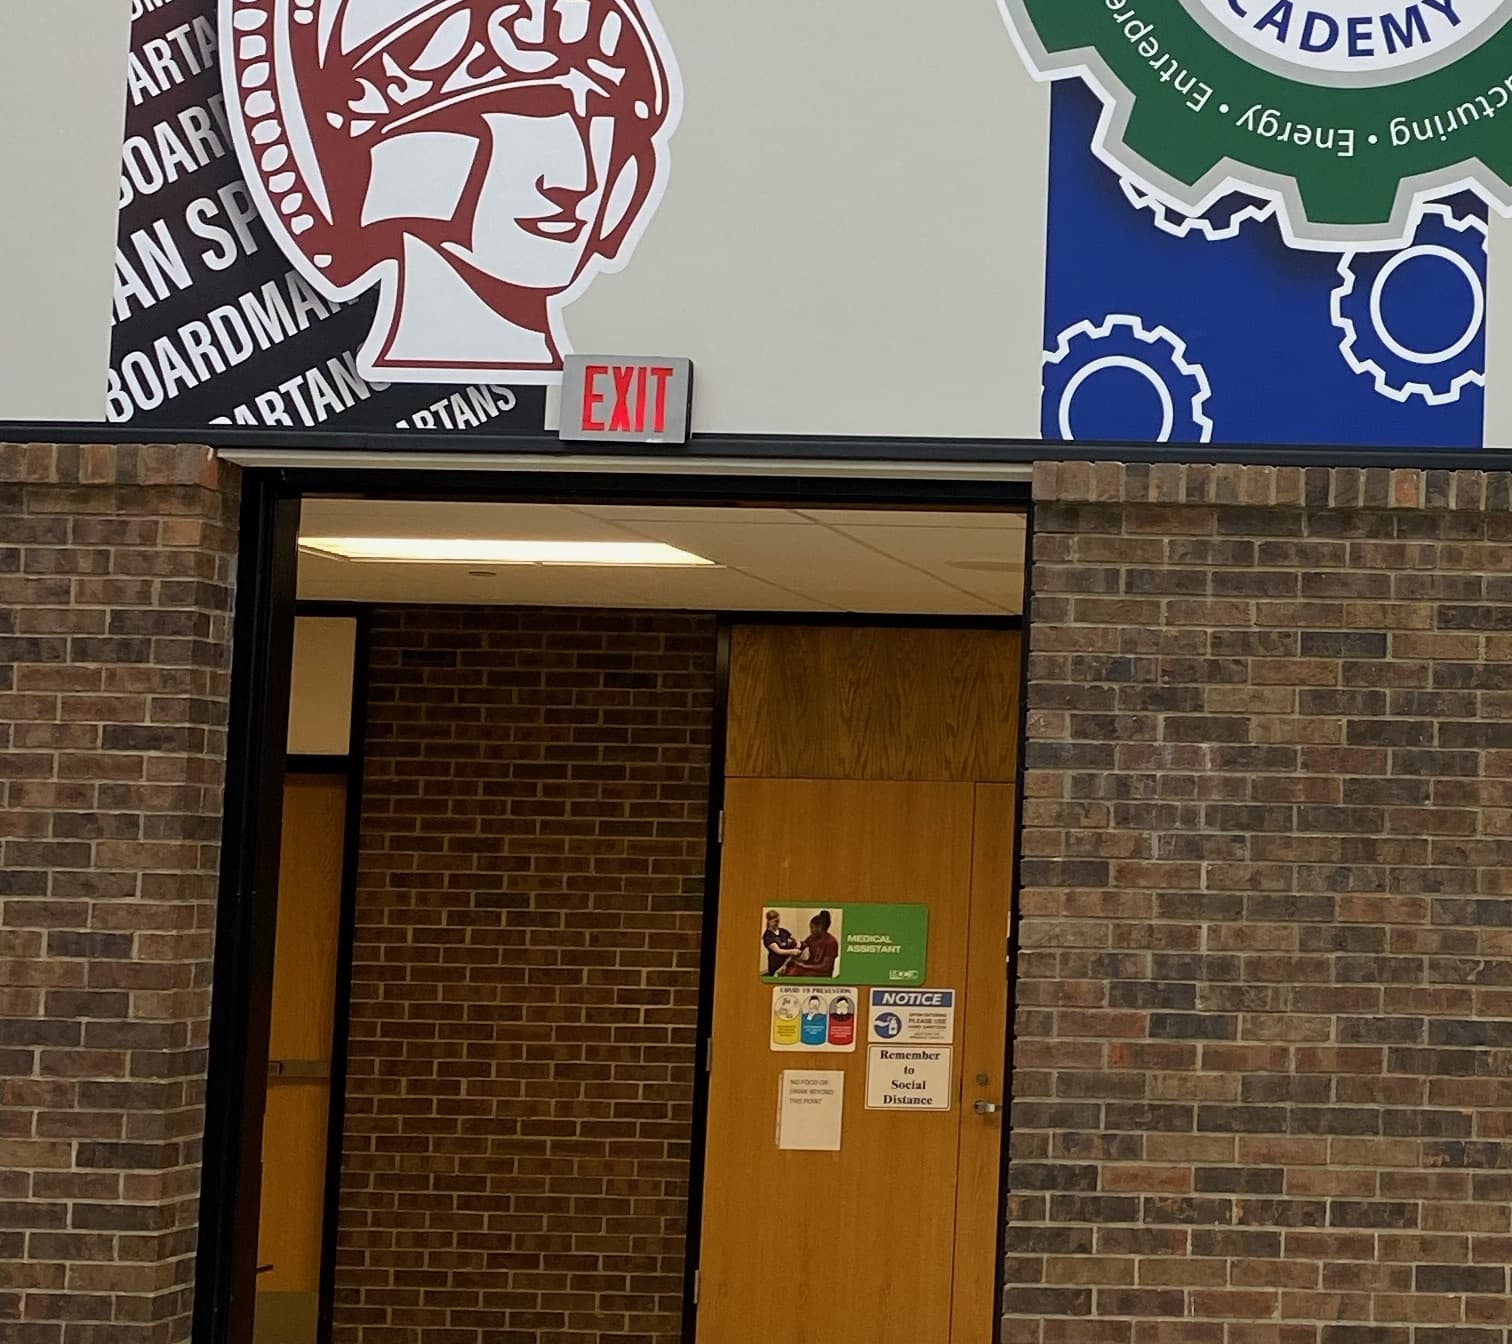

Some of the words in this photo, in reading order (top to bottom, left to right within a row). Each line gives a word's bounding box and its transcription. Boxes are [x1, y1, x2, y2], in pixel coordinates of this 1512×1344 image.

[1236, 104, 1356, 157] Energy
[114, 93, 235, 210] OAR
[111, 219, 193, 327] AN
[104, 269, 357, 424] BOARDMA
[208, 344, 392, 428] ARTAN
[582, 366, 673, 432] EXIT
[847, 935, 892, 944] MEDICAL
[847, 944, 901, 953] ASSISTANT
[882, 993, 943, 1005] NOTICE
[880, 1050, 941, 1060] Remember
[904, 1066, 915, 1075] to
[891, 1080, 926, 1090] Social
[883, 1095, 933, 1105] Distance
